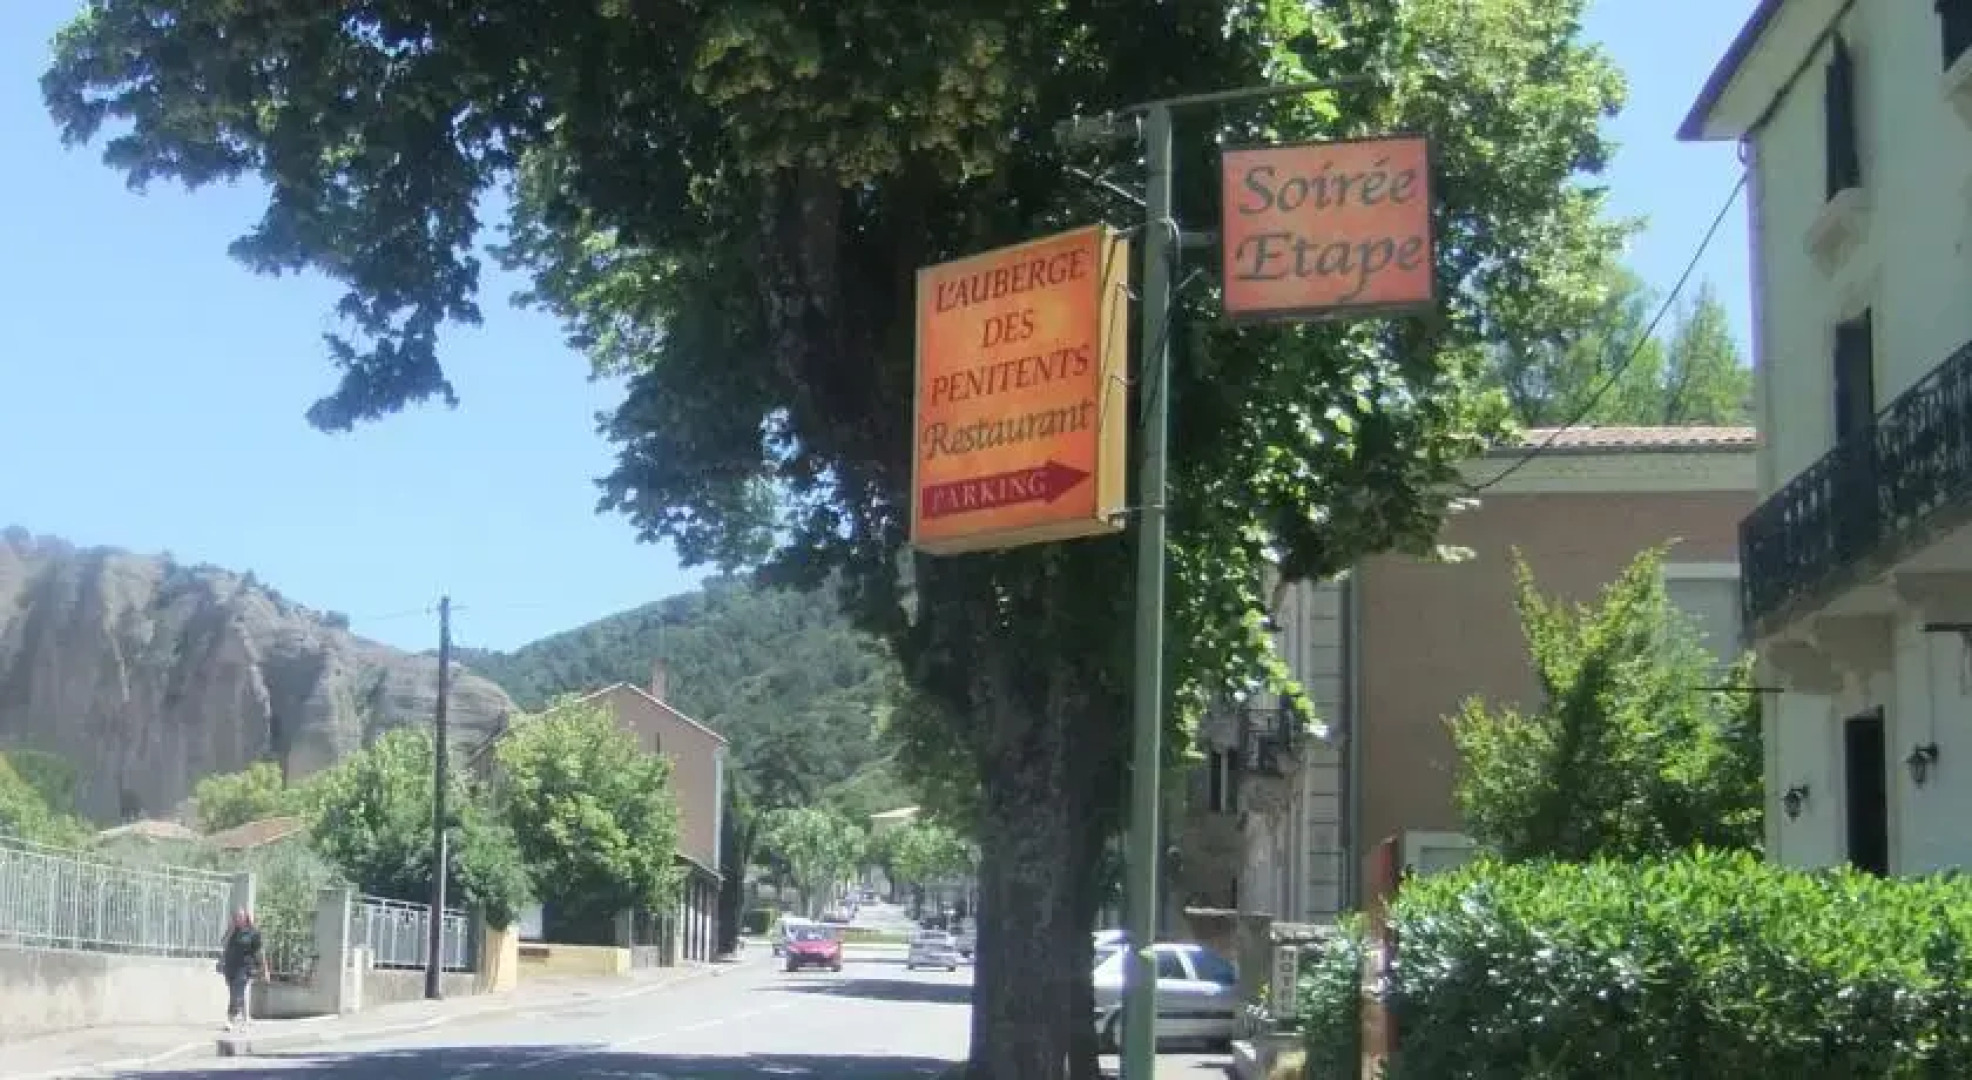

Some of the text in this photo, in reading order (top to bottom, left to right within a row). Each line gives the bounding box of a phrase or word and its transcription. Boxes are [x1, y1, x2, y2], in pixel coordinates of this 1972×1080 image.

[1239, 156, 1418, 215] Soirée
[936, 248, 1088, 314] L'AUBERGE
[1235, 230, 1424, 304] Etape
[984, 309, 1034, 349] DES
[931, 345, 1090, 406] PENITENTS
[923, 398, 1094, 460] Restaurant
[932, 471, 1050, 513] PARKING
